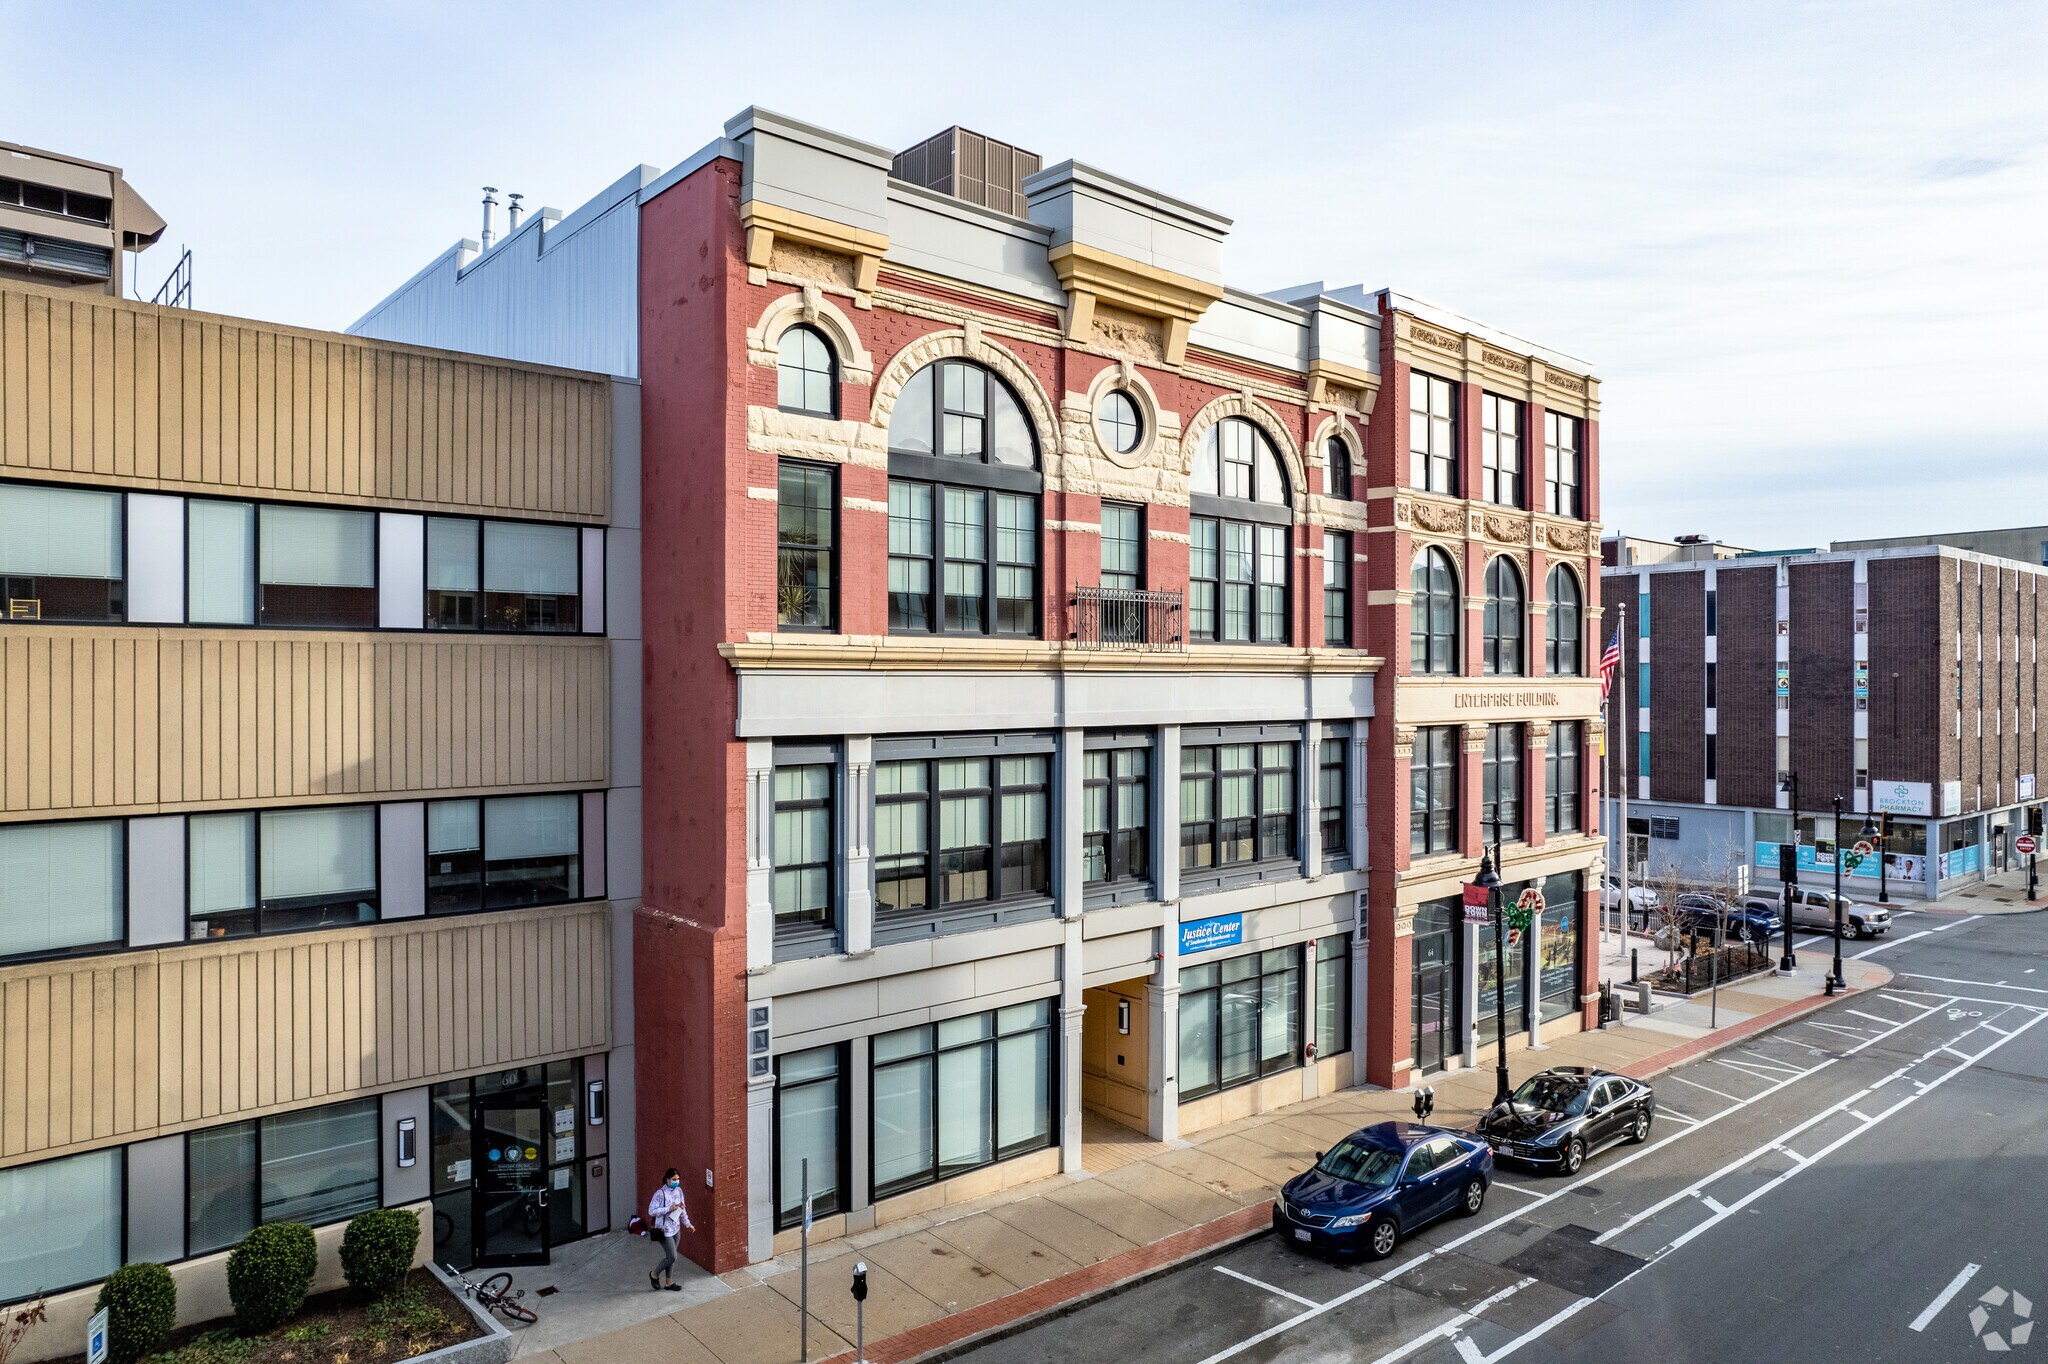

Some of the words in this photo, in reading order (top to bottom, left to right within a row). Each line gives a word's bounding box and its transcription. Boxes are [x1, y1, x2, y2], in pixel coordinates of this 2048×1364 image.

[1454, 693, 1515, 708] ENTERPRISE
[1879, 797, 1924, 806] BROCKTON
[1879, 804, 1922, 813] PHARMACY
[1464, 905, 1488, 913] DOWN
[1181, 926, 1211, 942] Justice
[1213, 922, 1240, 935] Center
[502, 1073, 516, 1085] 60
